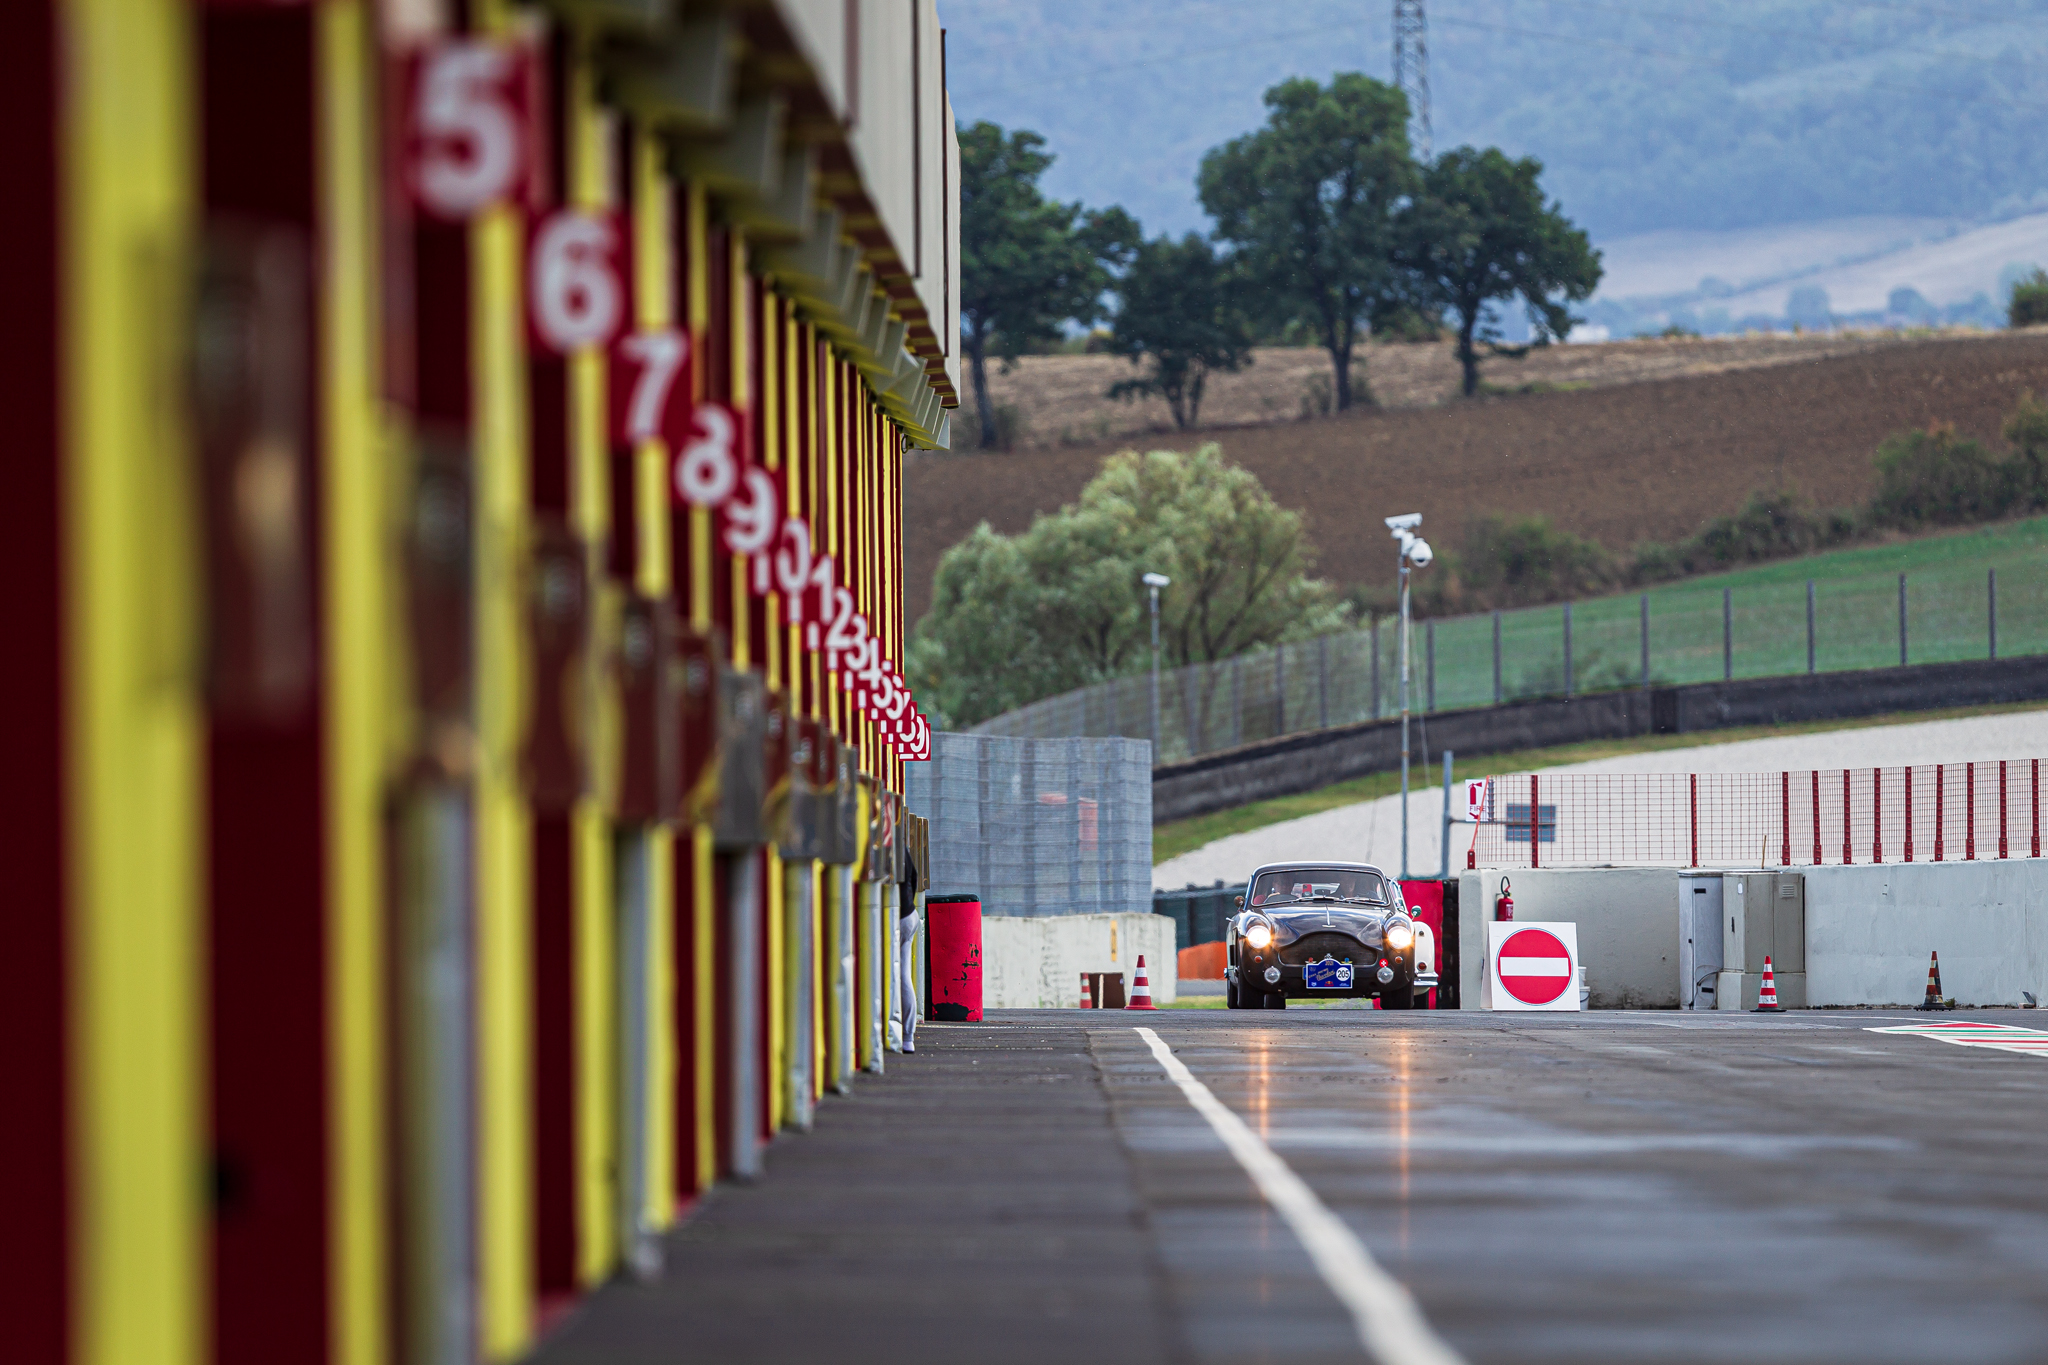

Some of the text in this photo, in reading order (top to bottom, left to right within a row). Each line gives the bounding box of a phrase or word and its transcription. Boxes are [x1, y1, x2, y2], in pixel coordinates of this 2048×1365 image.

[418, 42, 519, 215] 5
[532, 211, 622, 352] 6
[620, 333, 688, 440] 7
[675, 404, 736, 504] 8
[724, 466, 777, 550] 9
[1337, 970, 1349, 978] 205
